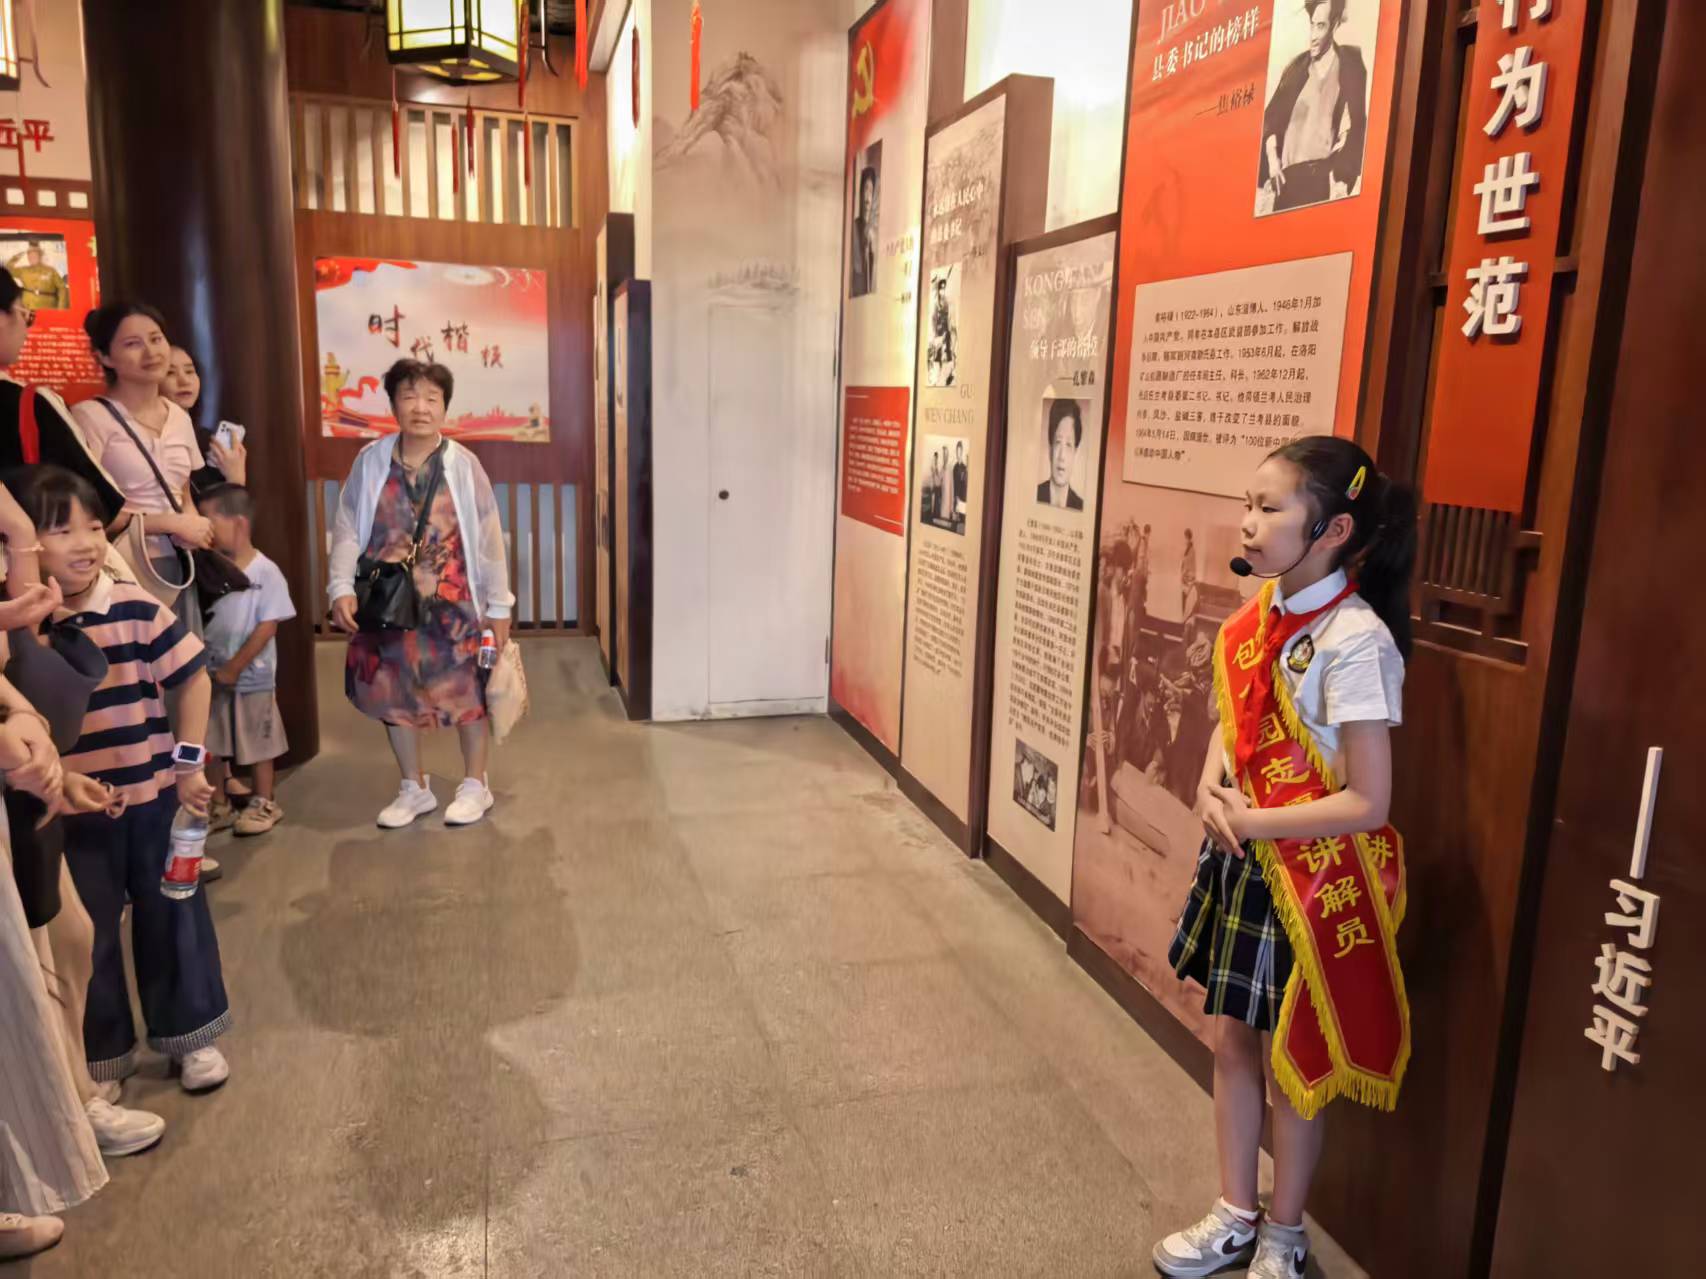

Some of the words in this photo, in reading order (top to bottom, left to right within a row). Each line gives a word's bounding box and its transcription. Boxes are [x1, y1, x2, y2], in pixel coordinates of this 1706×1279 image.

[1152, 6, 1260, 82] 县委书记的榜样
